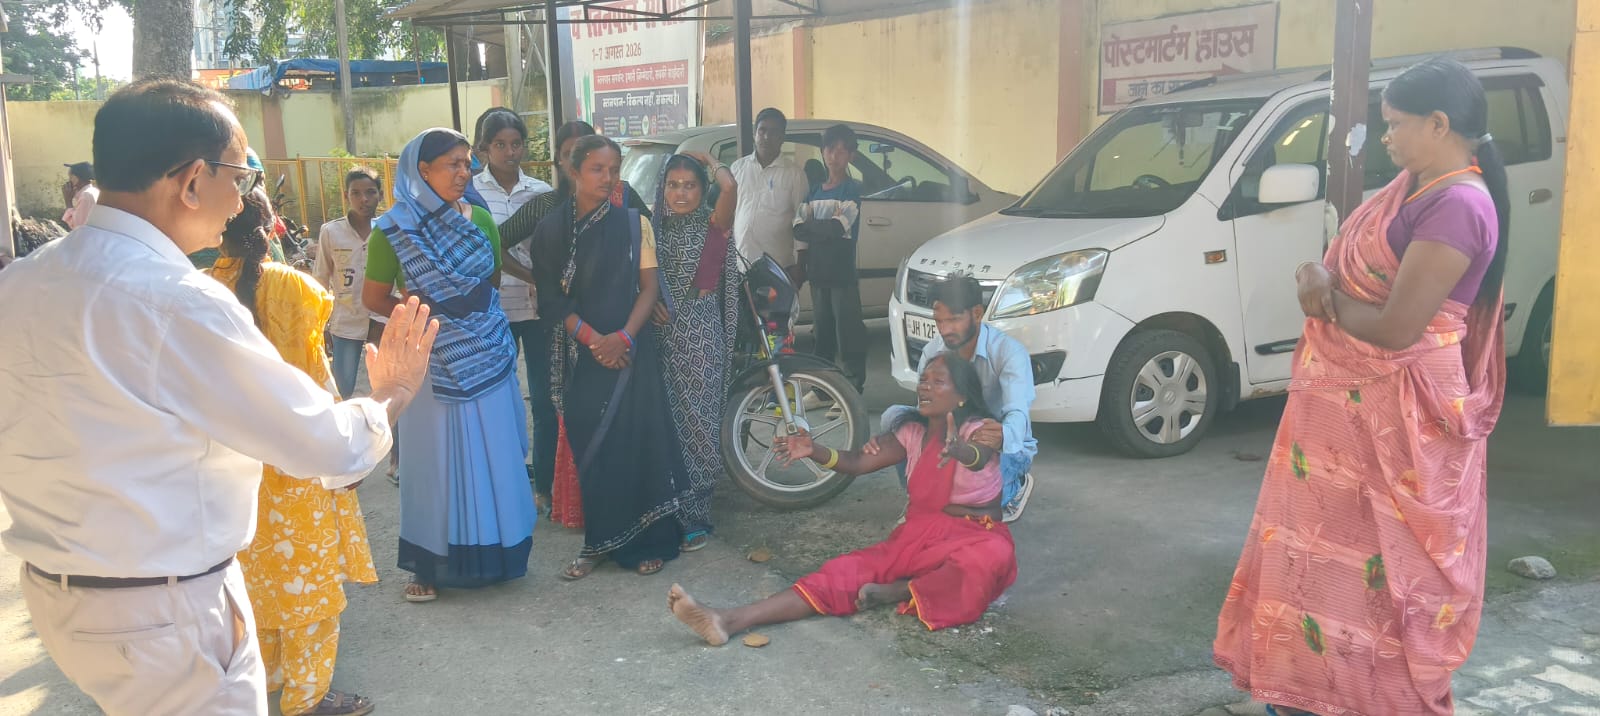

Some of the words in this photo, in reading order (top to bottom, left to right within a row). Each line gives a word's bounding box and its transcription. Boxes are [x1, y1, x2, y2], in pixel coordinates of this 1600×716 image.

[605, 45, 624, 59] अगस्त
[626, 43, 642, 57] 2026
[1103, 25, 1191, 67] पोस्टमार्टम
[1195, 24, 1259, 63] हाउस
[1150, 80, 1165, 95] का
[912, 320, 921, 336] JH
